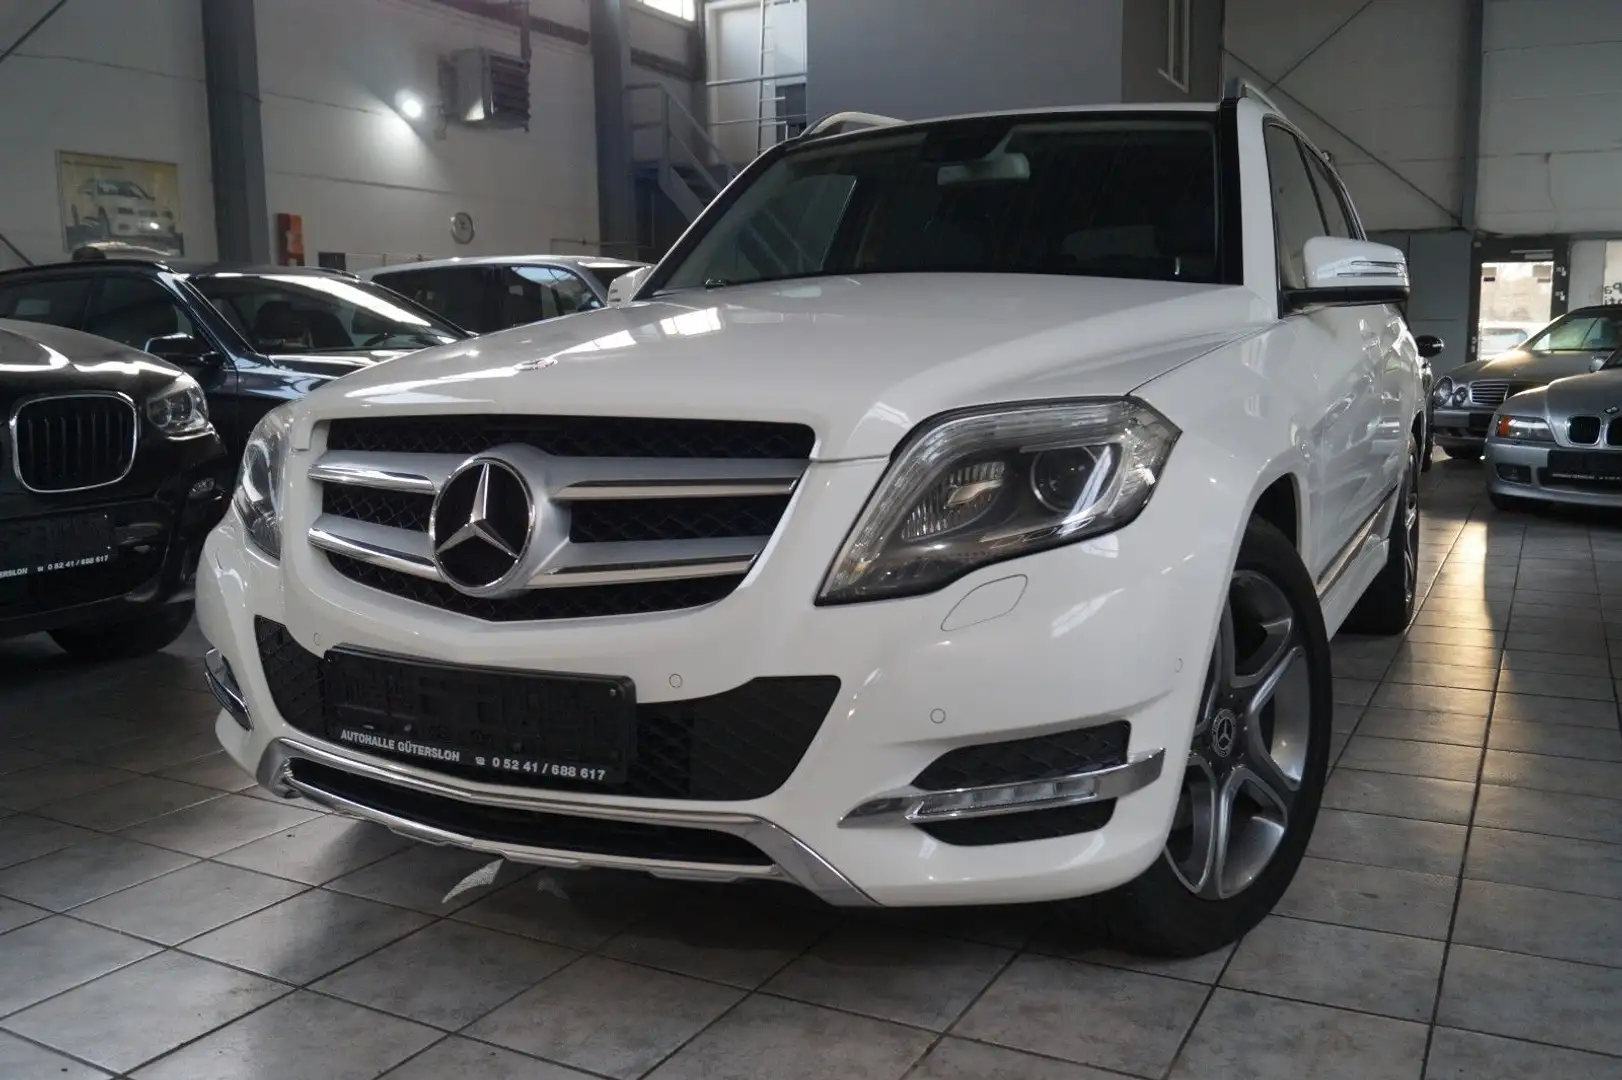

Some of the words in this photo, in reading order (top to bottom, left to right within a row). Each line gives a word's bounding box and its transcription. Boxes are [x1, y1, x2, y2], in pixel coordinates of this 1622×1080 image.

[340, 729, 395, 750] AUTOHALLE
[397, 740, 460, 762] GÜTERSLOH
[492, 757, 500, 768] 0
[503, 758, 519, 770] 52
[523, 761, 538, 773] 41
[541, 763, 548, 774] /
[551, 764, 577, 777] 688
[580, 768, 606, 780] 617
